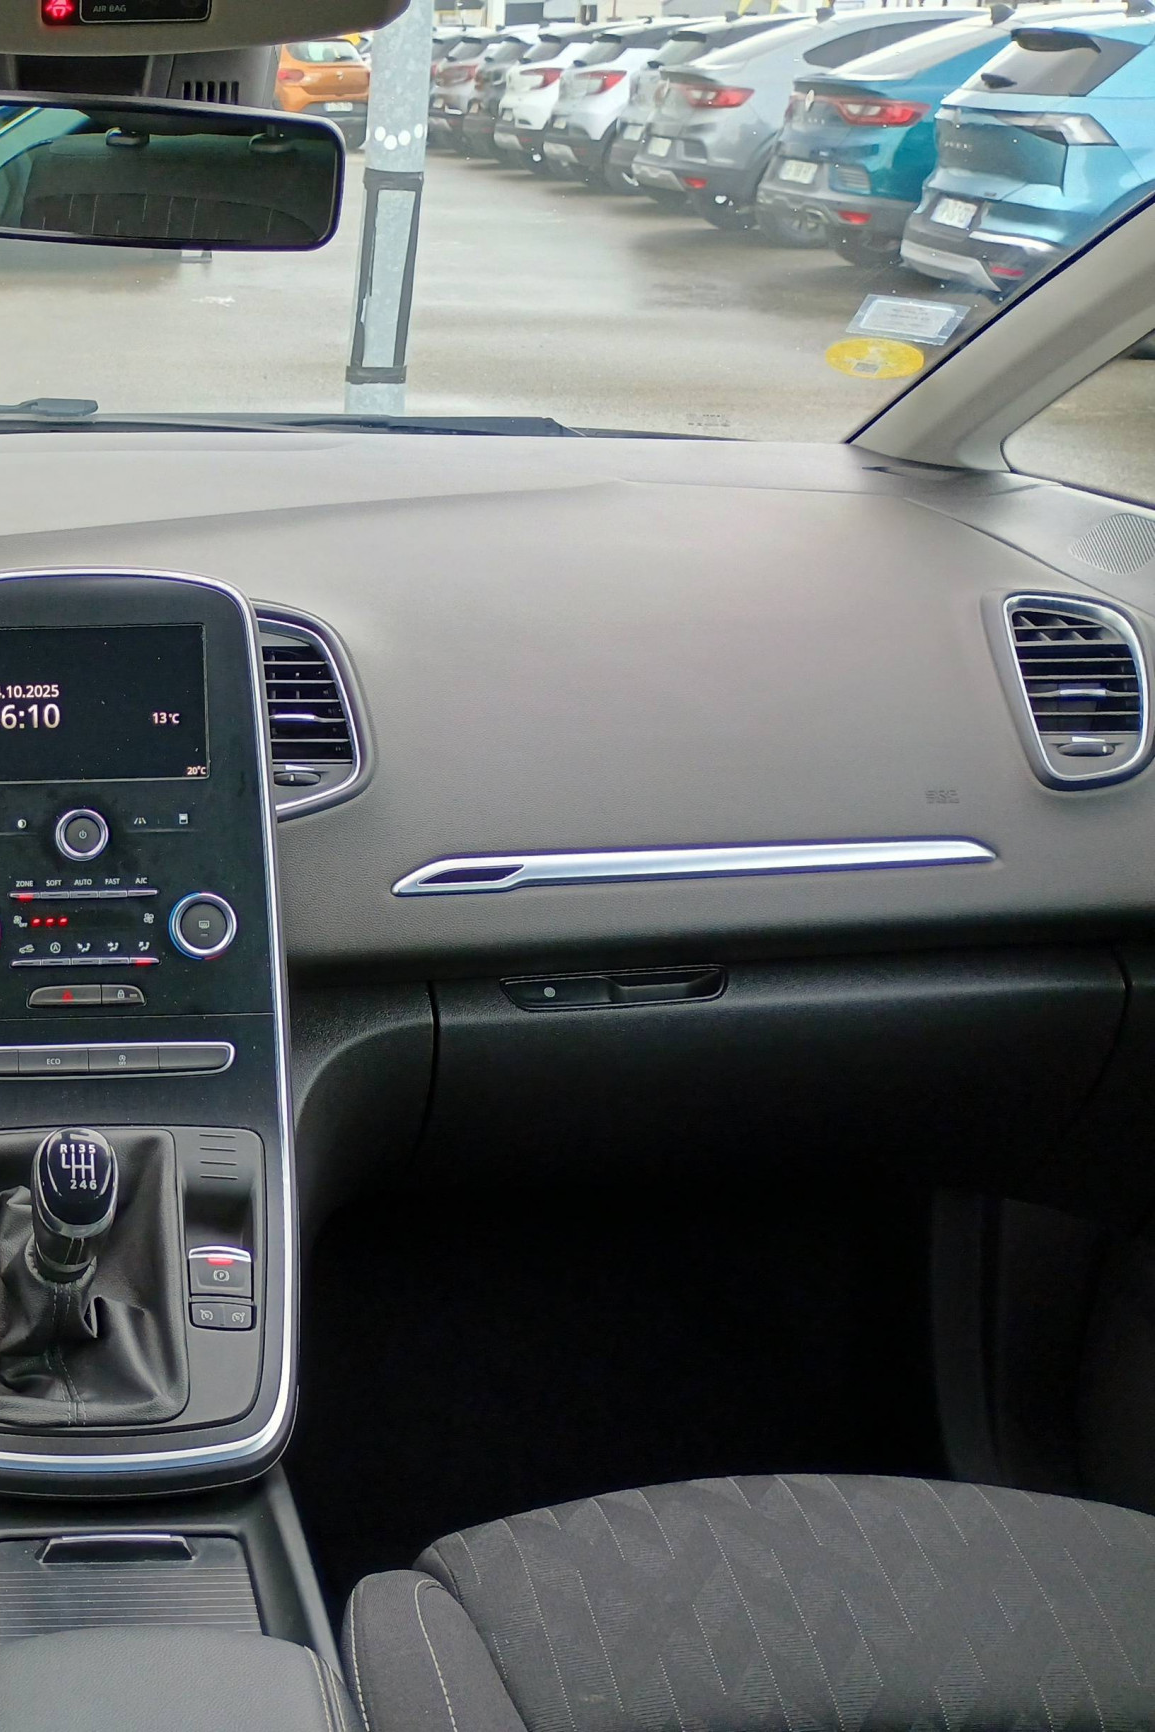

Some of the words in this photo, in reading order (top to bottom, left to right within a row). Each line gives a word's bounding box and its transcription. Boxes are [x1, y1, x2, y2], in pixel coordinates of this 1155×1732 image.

[187, 766, 207, 776] 20°C
[46, 879, 62, 887] SOFT
[74, 878, 93, 886] AUTO
[60, 1143, 68, 1154] R
[69, 1143, 76, 1154] 1
[78, 1143, 86, 1154] 3
[88, 1144, 96, 1154] 5
[70, 1179, 77, 1190] 2
[79, 1179, 88, 1190] 4
[89, 1179, 97, 1190] 6
